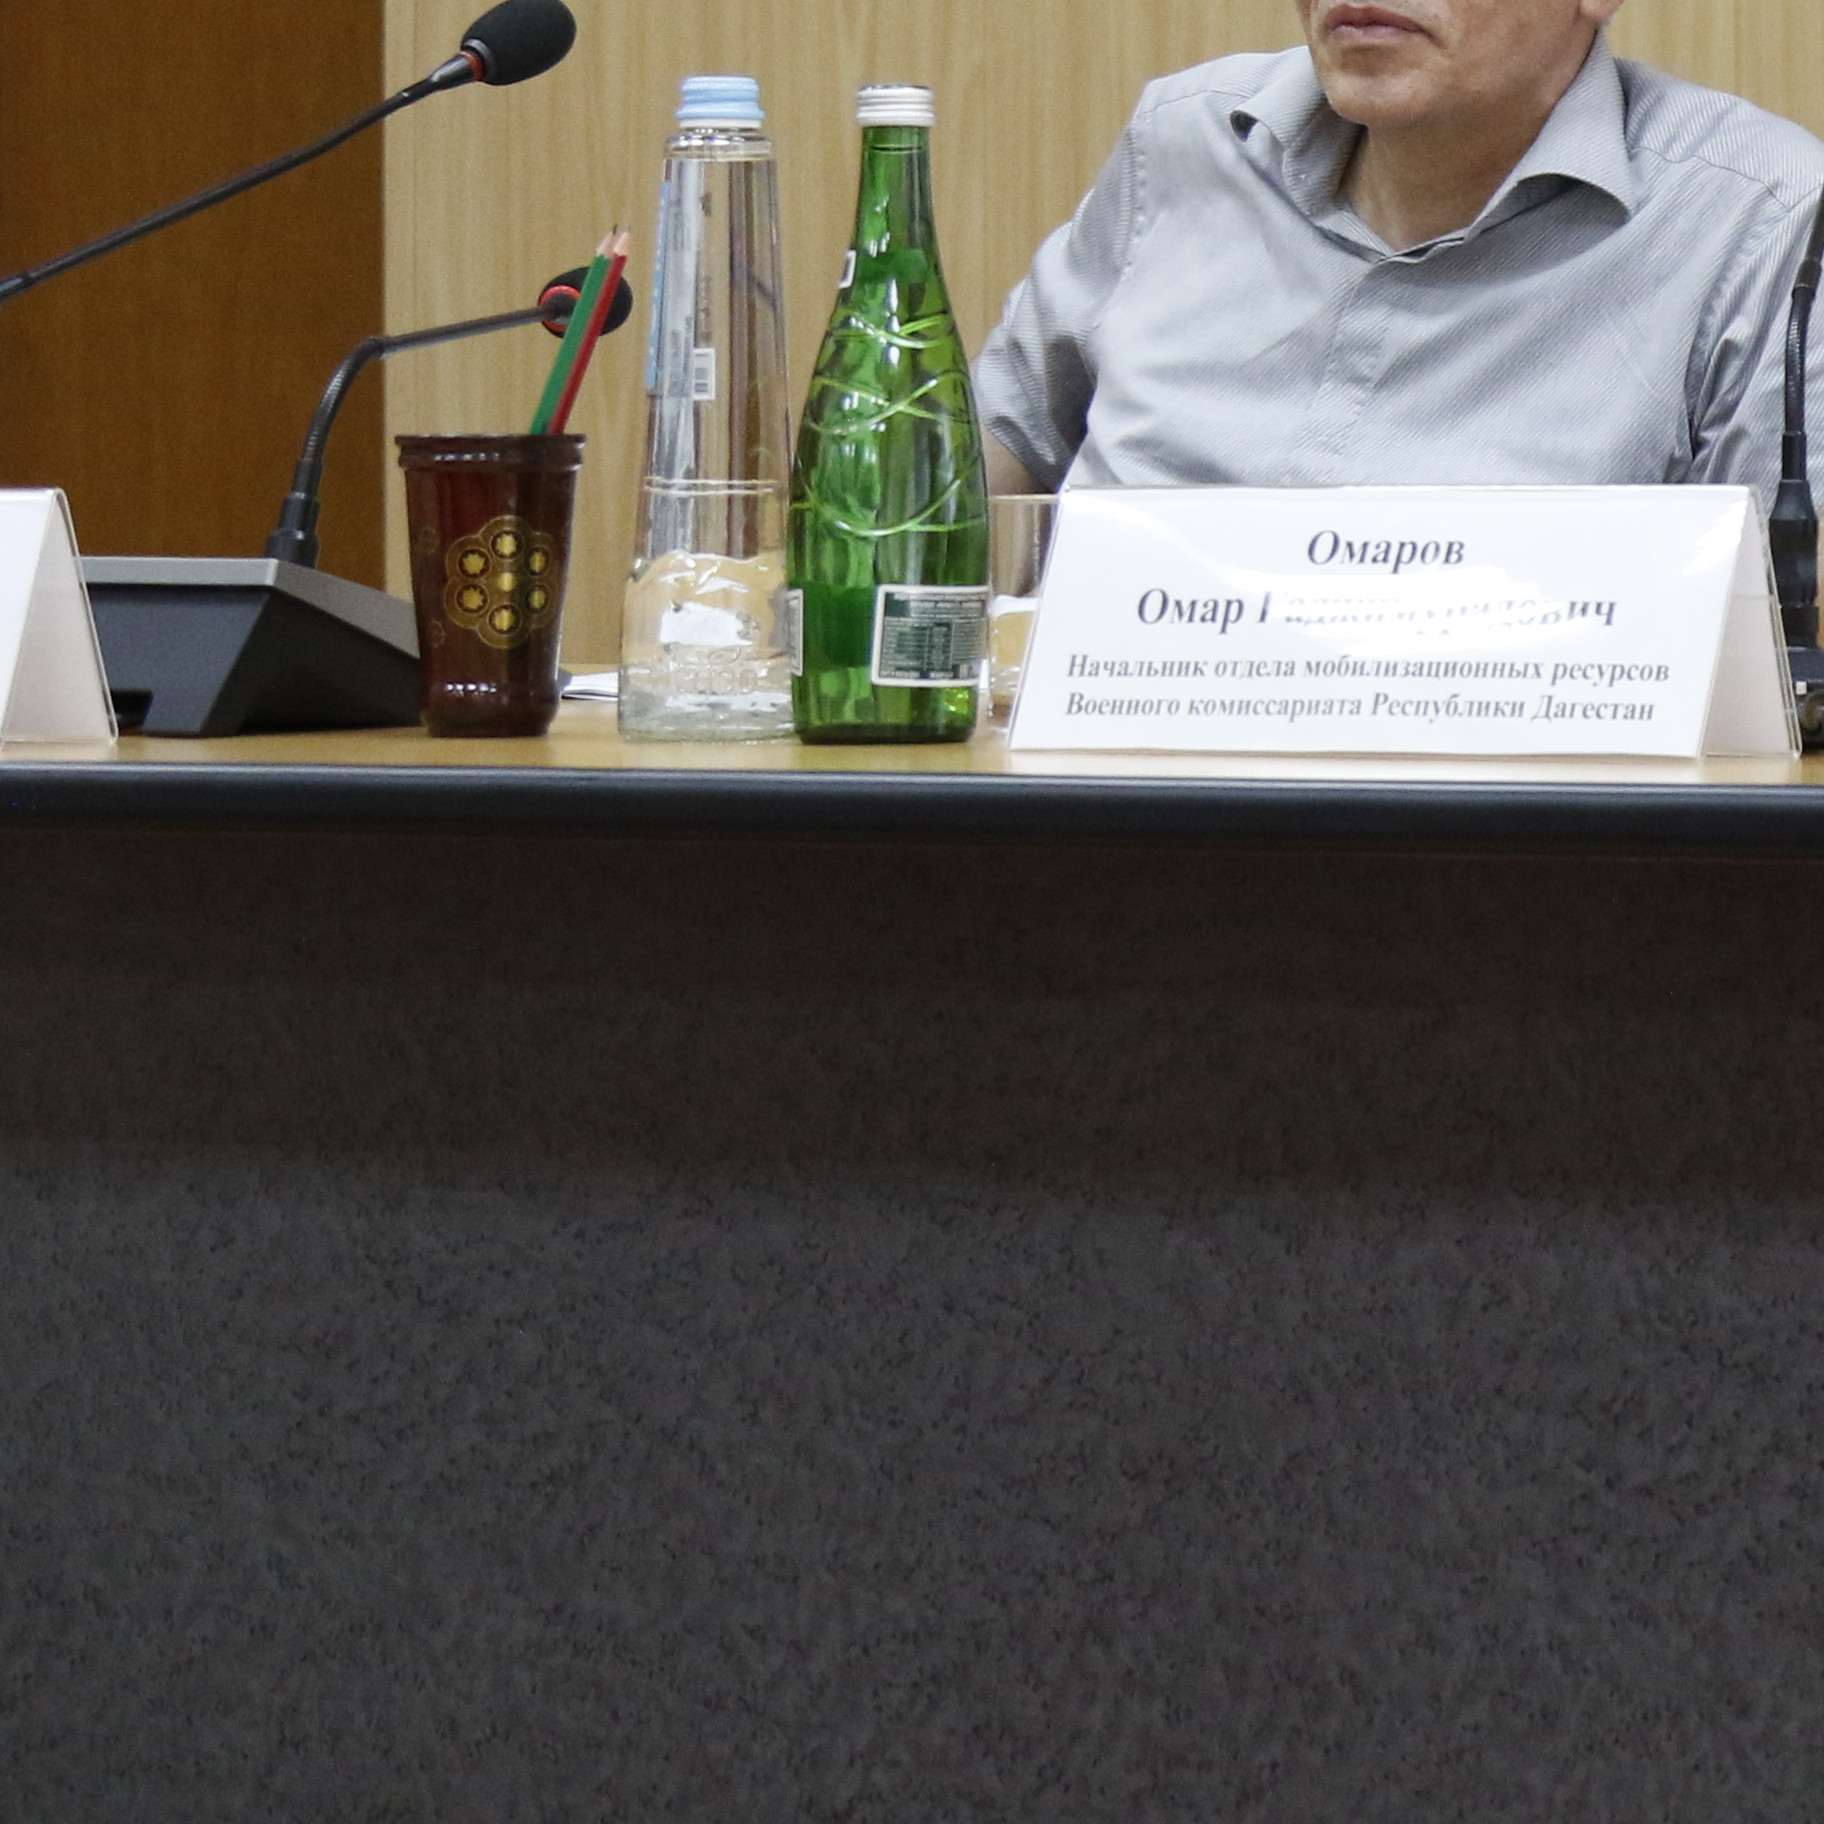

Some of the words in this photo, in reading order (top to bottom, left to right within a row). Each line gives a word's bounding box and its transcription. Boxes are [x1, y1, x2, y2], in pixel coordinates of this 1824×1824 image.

[1307, 529, 1465, 575] Омаров
[1137, 587, 1245, 635] Омар
[1067, 654, 1208, 678] Начальник
[1214, 657, 1296, 679] отдела
[1304, 655, 1543, 680] мобилизационных
[1550, 661, 1670, 687] ресурсов
[1066, 692, 1181, 716] Военного
[1187, 697, 1362, 723] комиссариата
[1371, 692, 1526, 724] Республики
[1531, 695, 1655, 722] Дагестан
